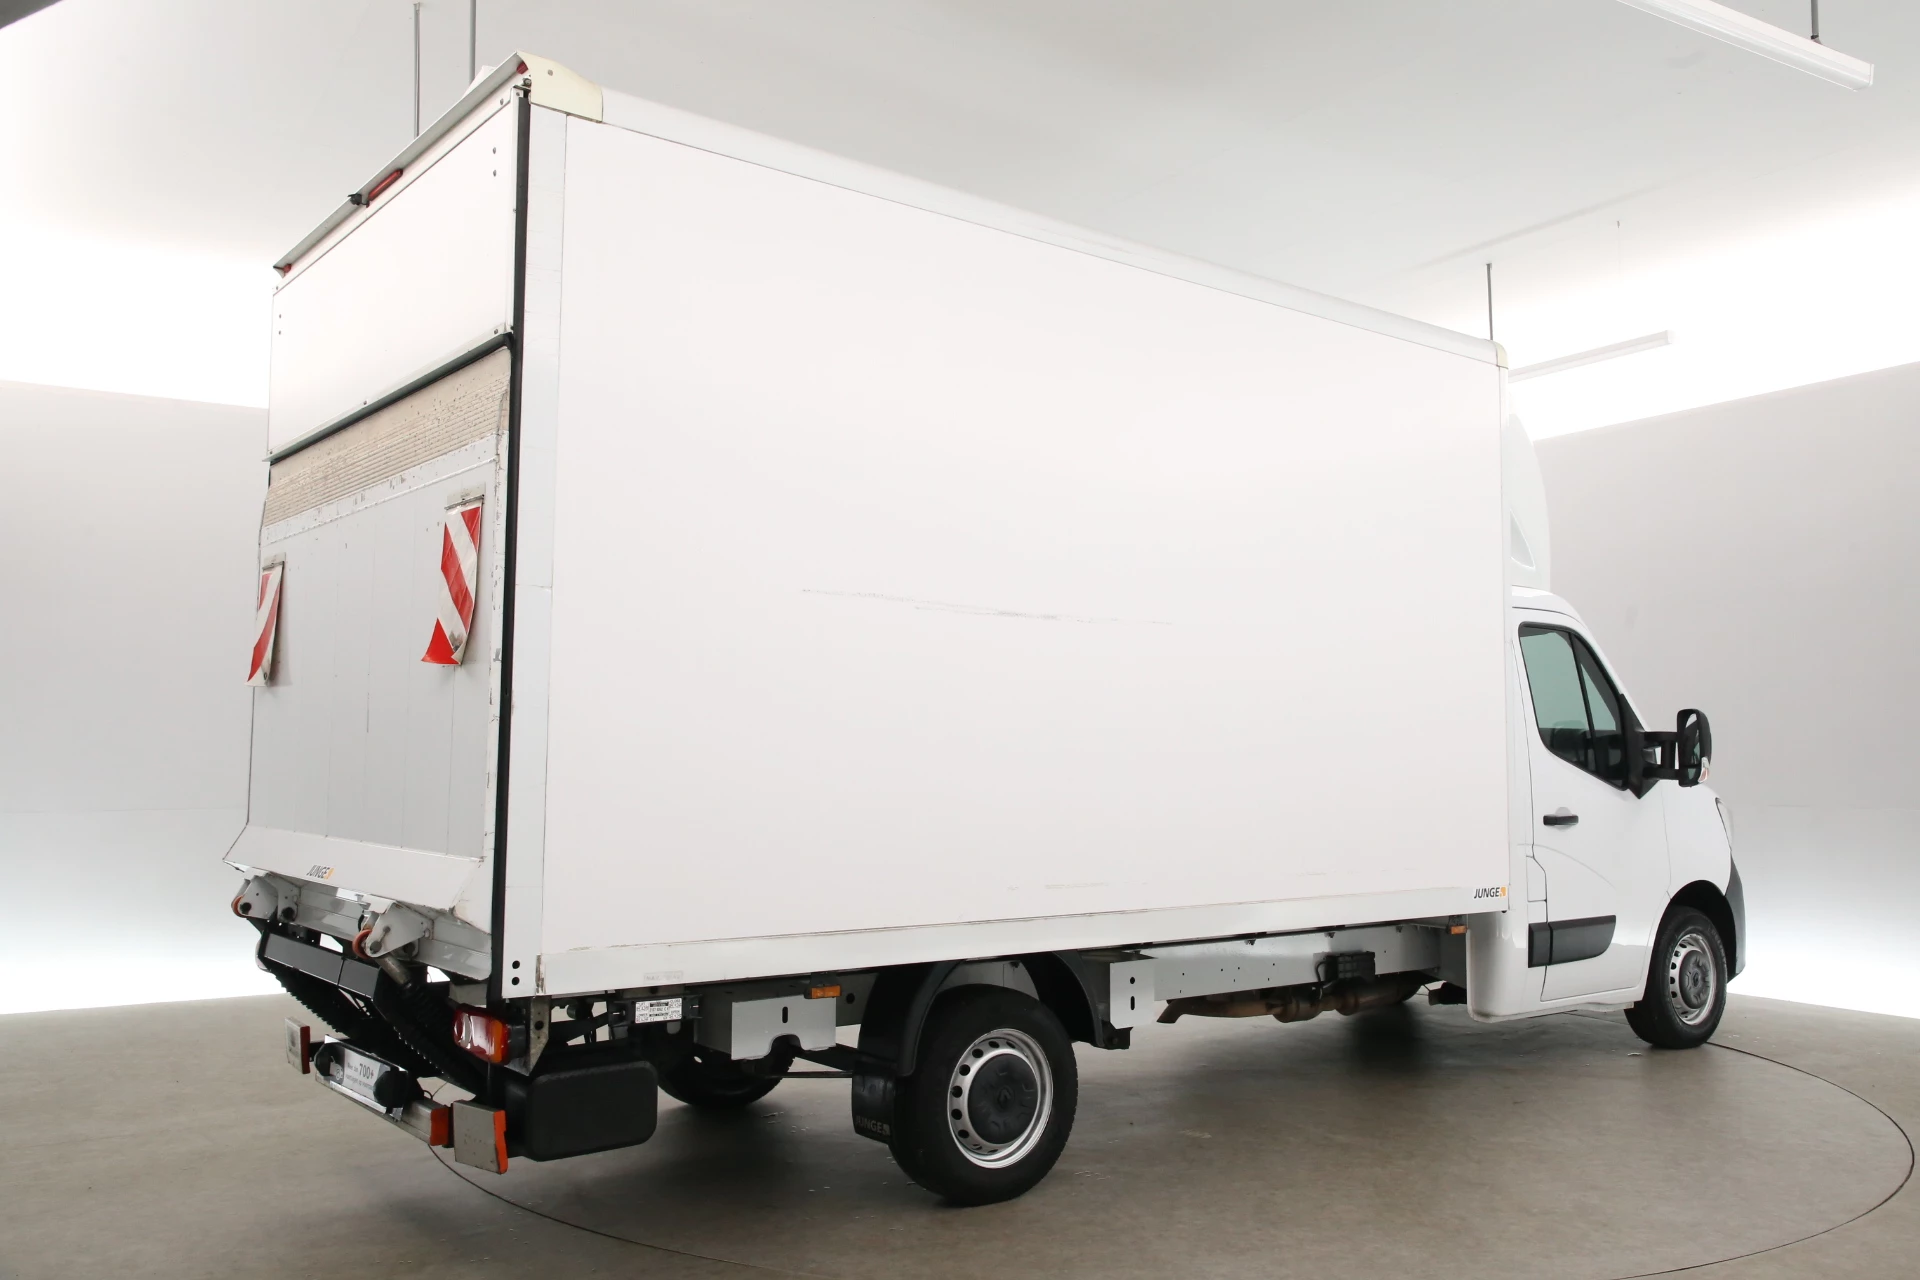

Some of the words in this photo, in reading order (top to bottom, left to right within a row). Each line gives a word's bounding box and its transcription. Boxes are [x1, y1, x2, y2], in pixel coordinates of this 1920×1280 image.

[306, 864, 330, 879] JUNGE
[1473, 887, 1500, 899] JUNGE
[359, 1062, 374, 1080] 700+
